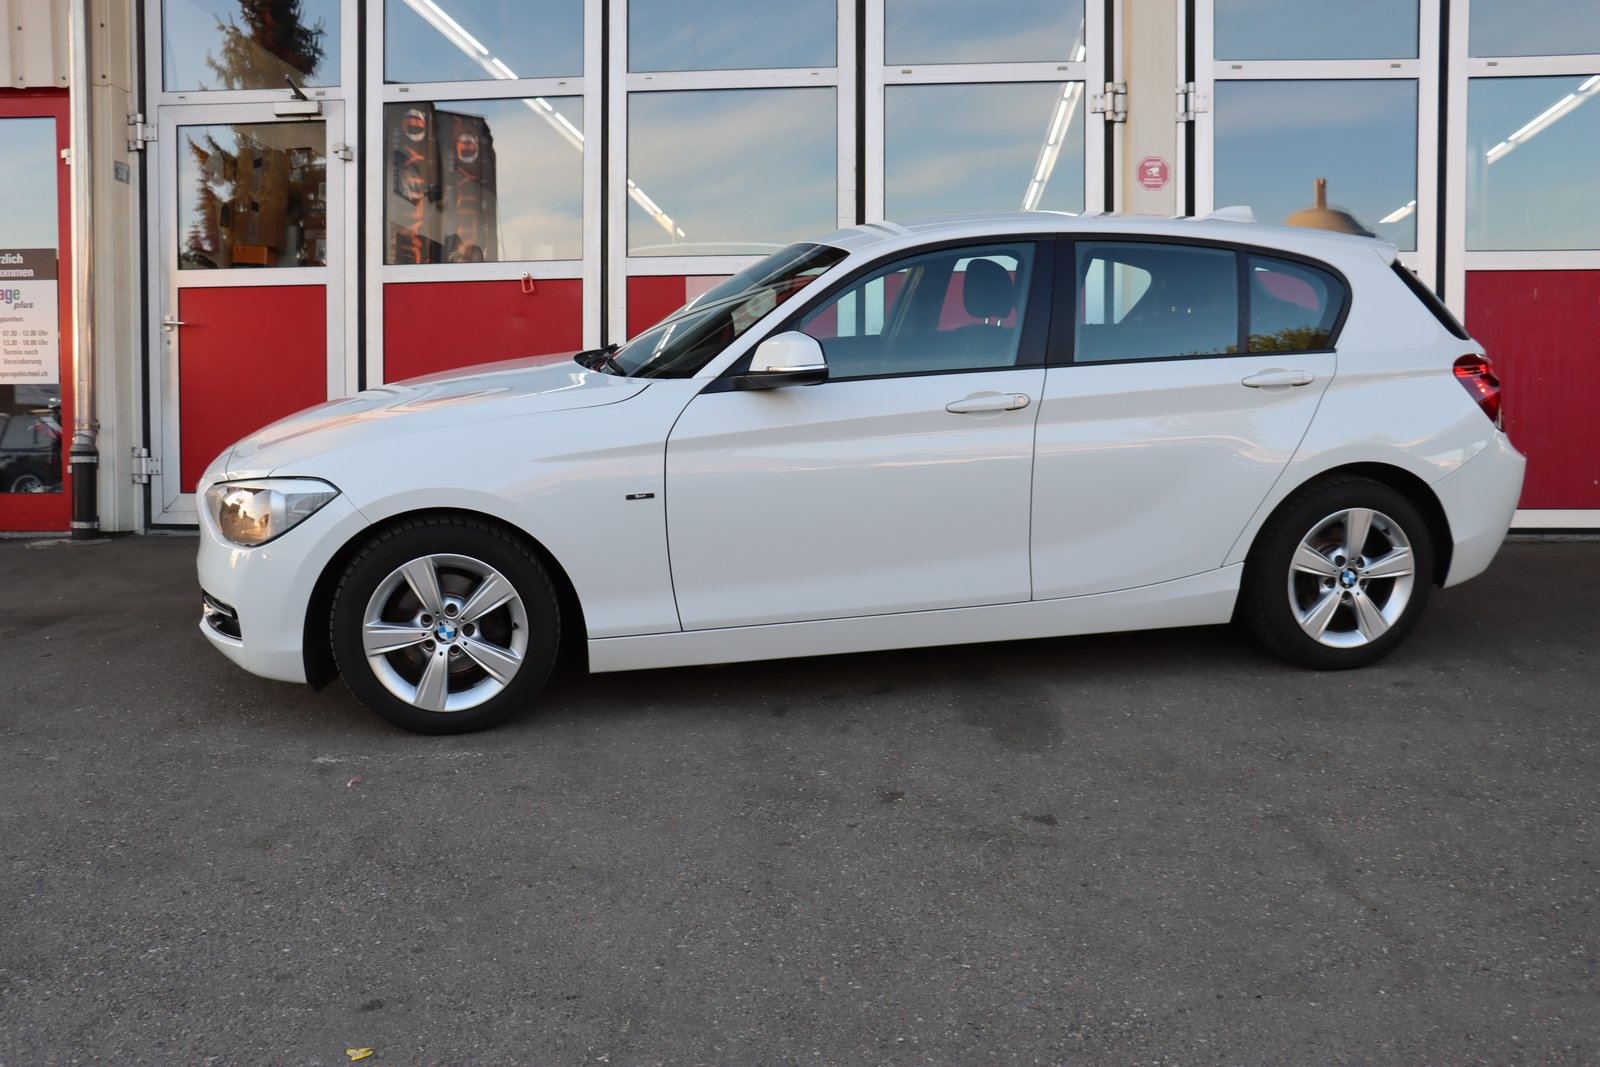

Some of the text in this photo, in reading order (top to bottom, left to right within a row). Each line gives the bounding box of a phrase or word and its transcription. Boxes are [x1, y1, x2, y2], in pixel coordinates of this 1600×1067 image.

[0, 269, 34, 278] ommen
[0, 289, 21, 304] age
[13, 301, 34, 310] plus
